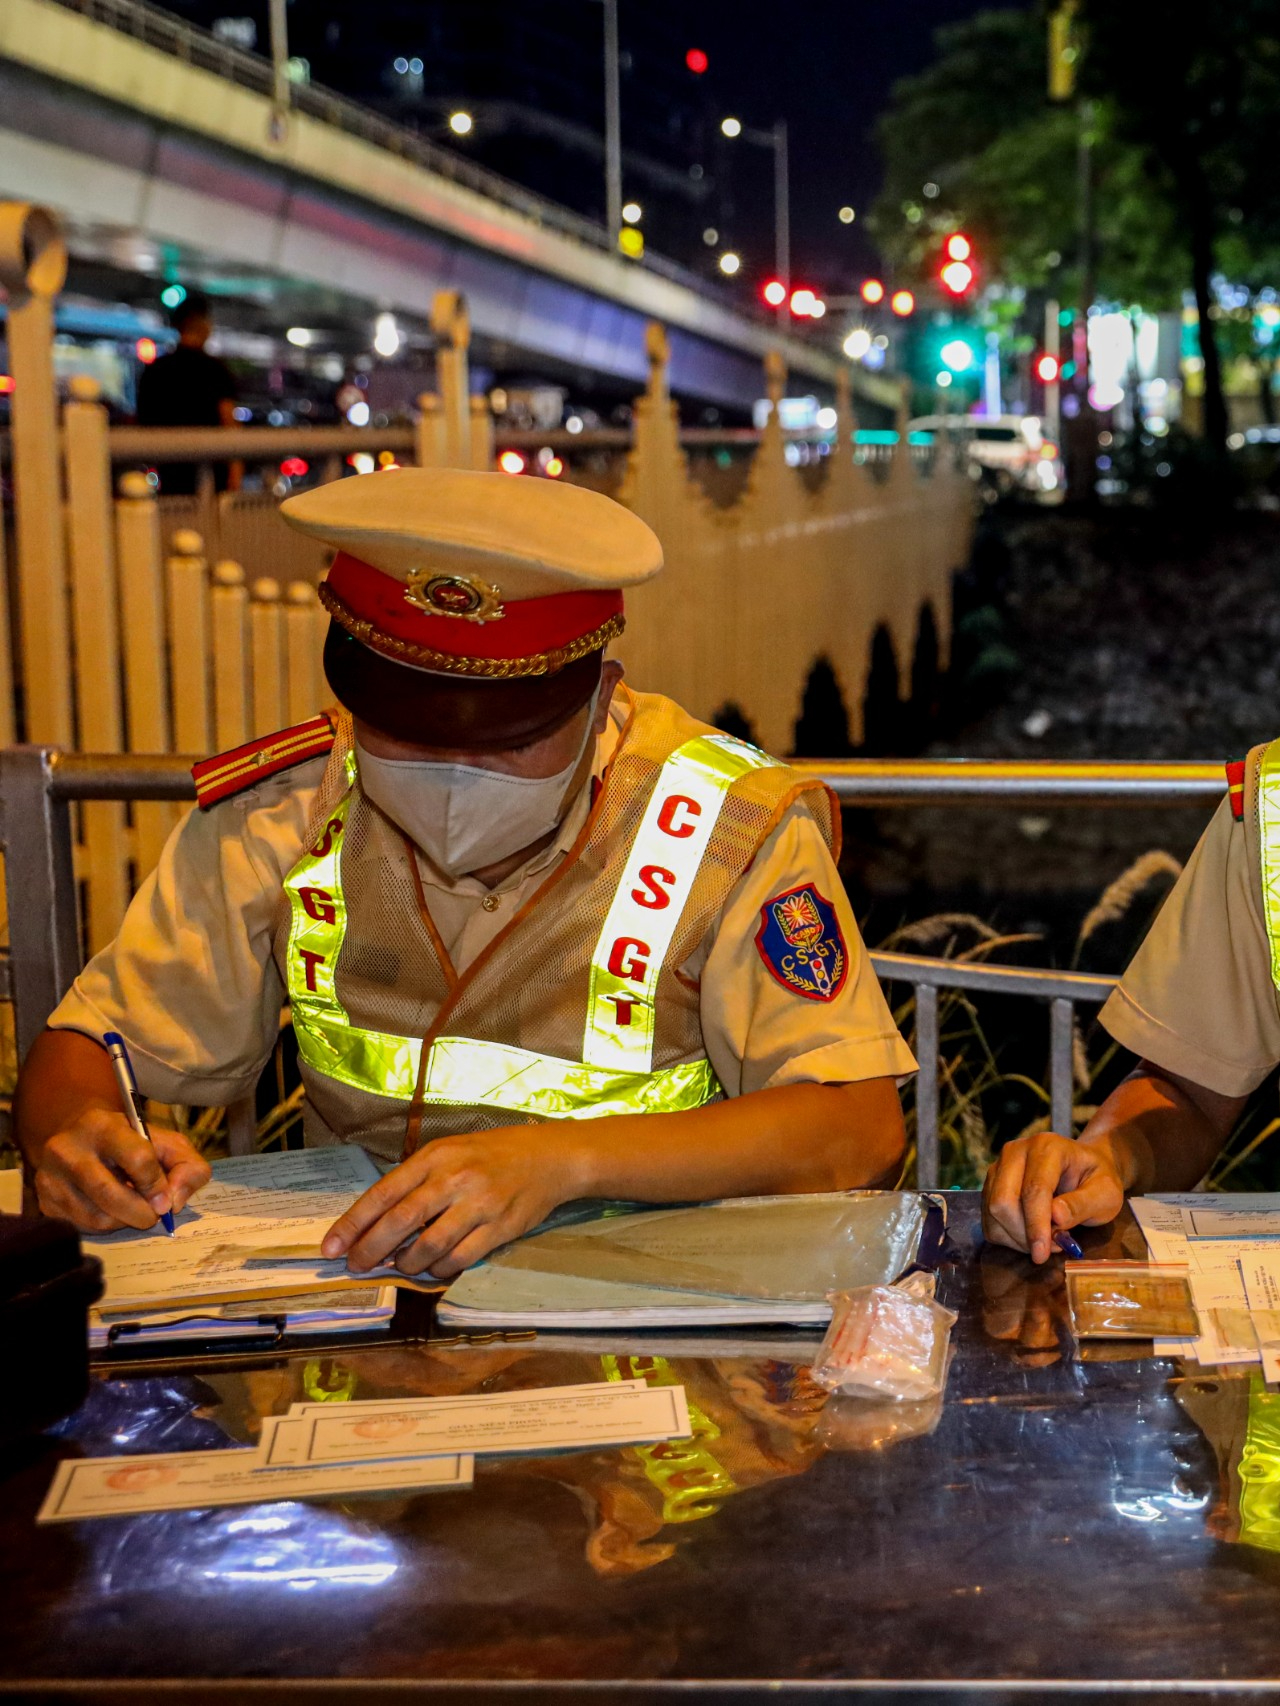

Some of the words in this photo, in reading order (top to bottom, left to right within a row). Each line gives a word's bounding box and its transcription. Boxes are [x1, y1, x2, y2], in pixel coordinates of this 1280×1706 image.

[297, 818, 344, 993] SGT
[606, 794, 702, 1026] CSGT
[781, 939, 837, 971] CSGT
